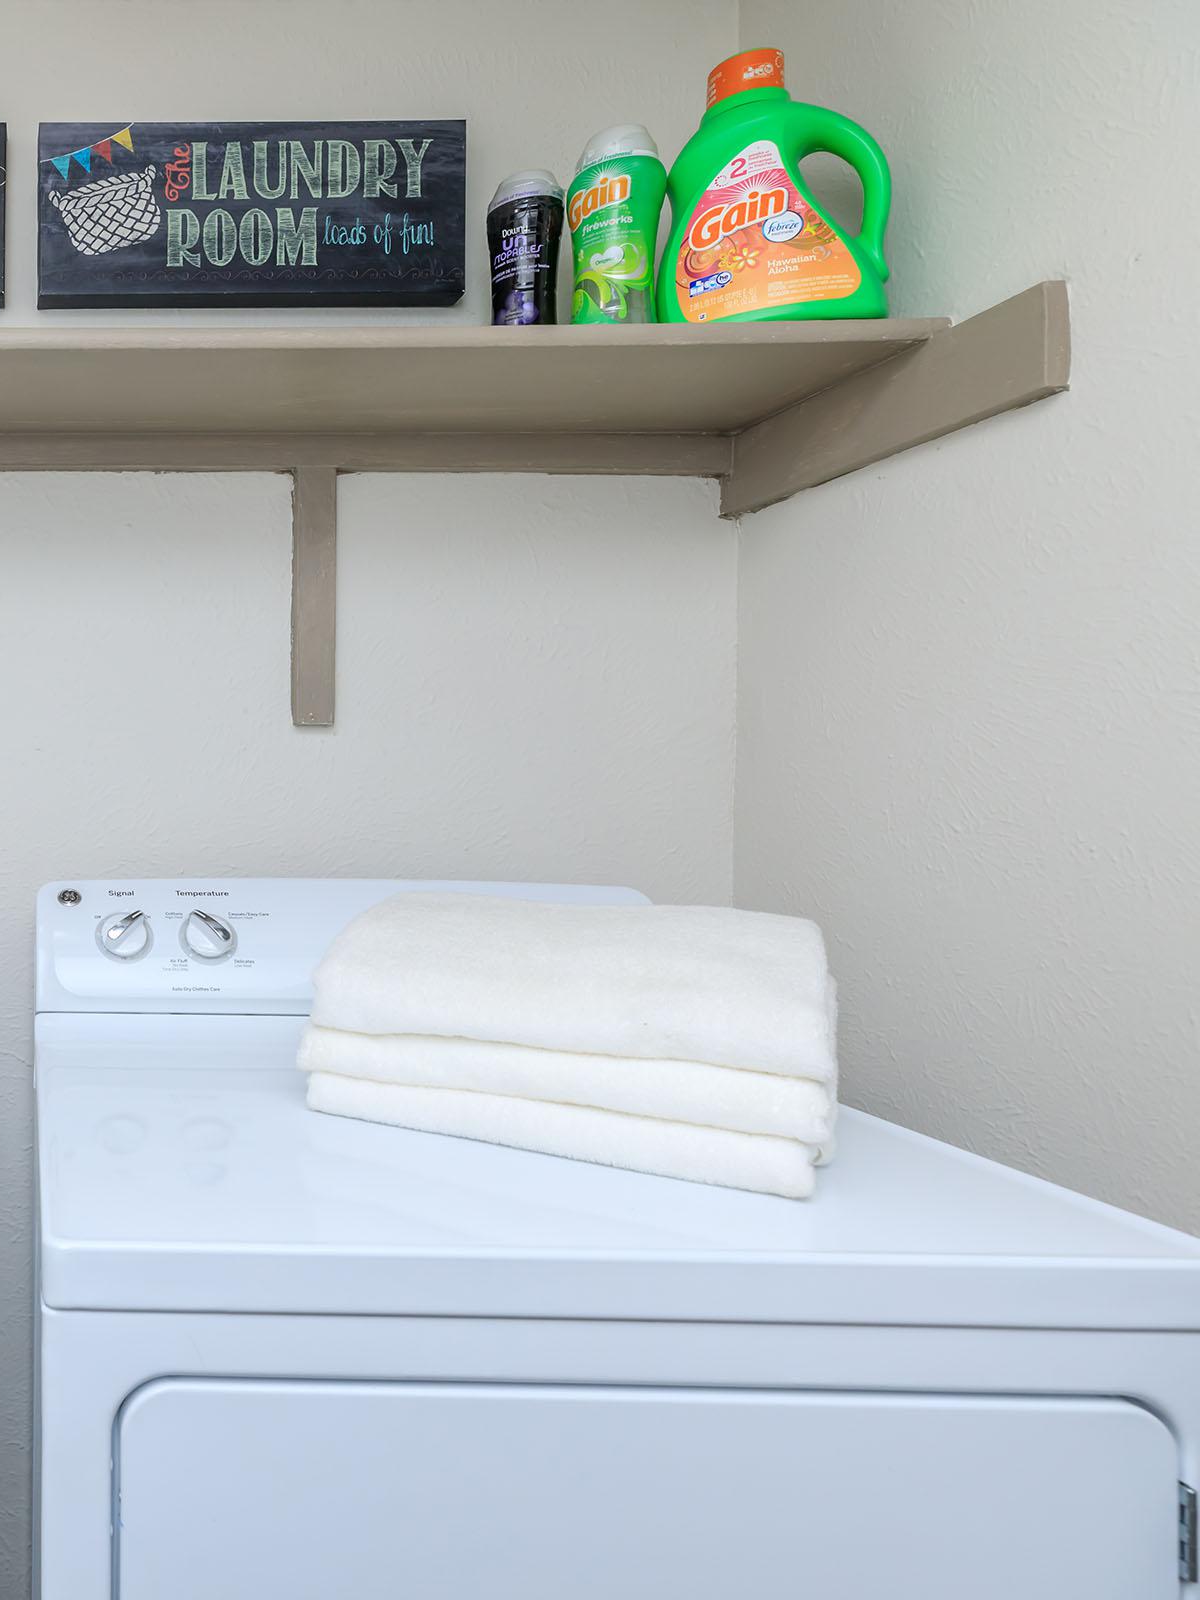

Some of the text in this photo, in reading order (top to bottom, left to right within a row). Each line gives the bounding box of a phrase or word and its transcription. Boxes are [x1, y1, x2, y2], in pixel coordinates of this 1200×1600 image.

[165, 142, 191, 202] The
[191, 138, 434, 201] LAUNDRY
[730, 157, 748, 179] 2
[568, 175, 631, 232] Gain
[582, 215, 633, 237] fireworks
[690, 188, 787, 250] Gain
[768, 221, 800, 235] febreze
[165, 206, 319, 268] ROOM
[321, 212, 434, 254] loads of fun!
[502, 224, 531, 239] Downy
[493, 244, 545, 266] STOPABLES
[767, 254, 817, 268] Hawaiian
[767, 264, 799, 276] Aloha
